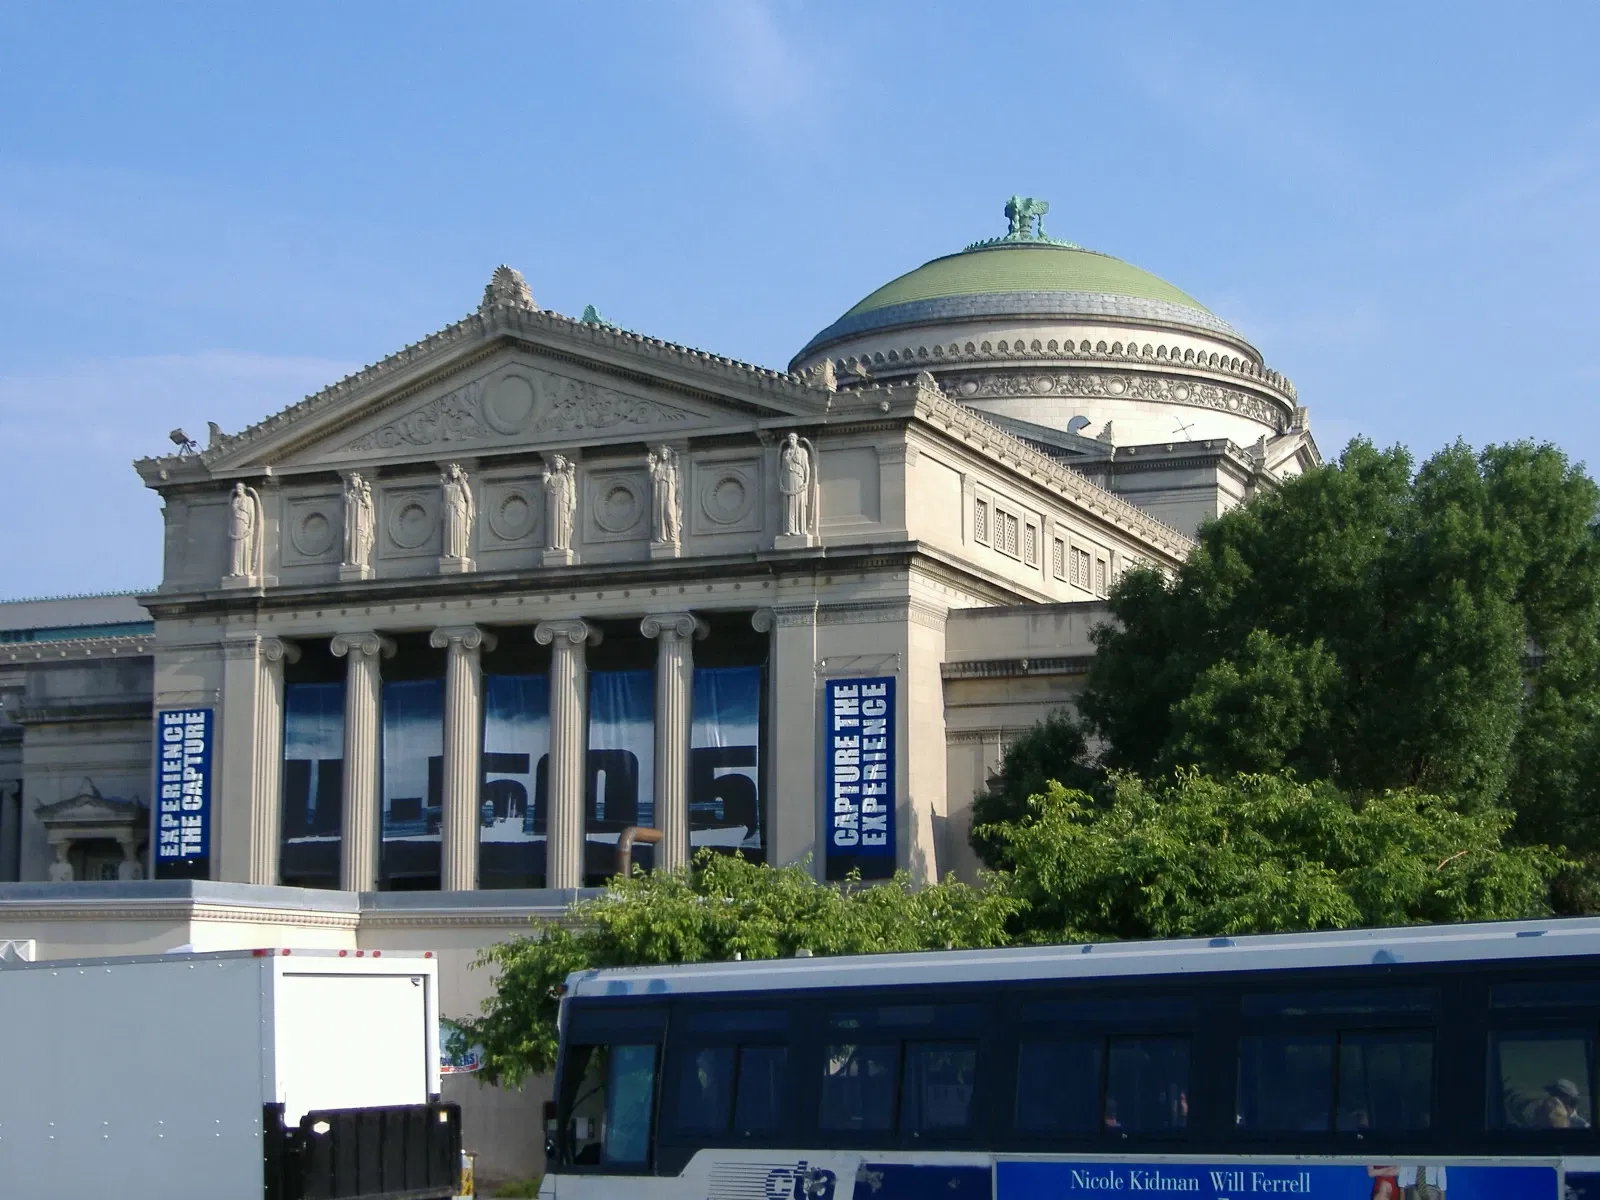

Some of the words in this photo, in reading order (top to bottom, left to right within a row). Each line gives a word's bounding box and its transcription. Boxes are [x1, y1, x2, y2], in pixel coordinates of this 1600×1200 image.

[834, 684, 860, 731] THE
[160, 712, 184, 857] EXPERIENCE
[182, 711, 205, 811] CAPTURE
[834, 735, 860, 846] CAPTURE
[862, 683, 887, 846] EXPERIENCE
[181, 815, 203, 857] THE
[1070, 1169, 1124, 1190] Nicole
[1128, 1170, 1200, 1191] Kidman
[1209, 1171, 1246, 1192] Will
[1251, 1172, 1312, 1193] Ferrell
